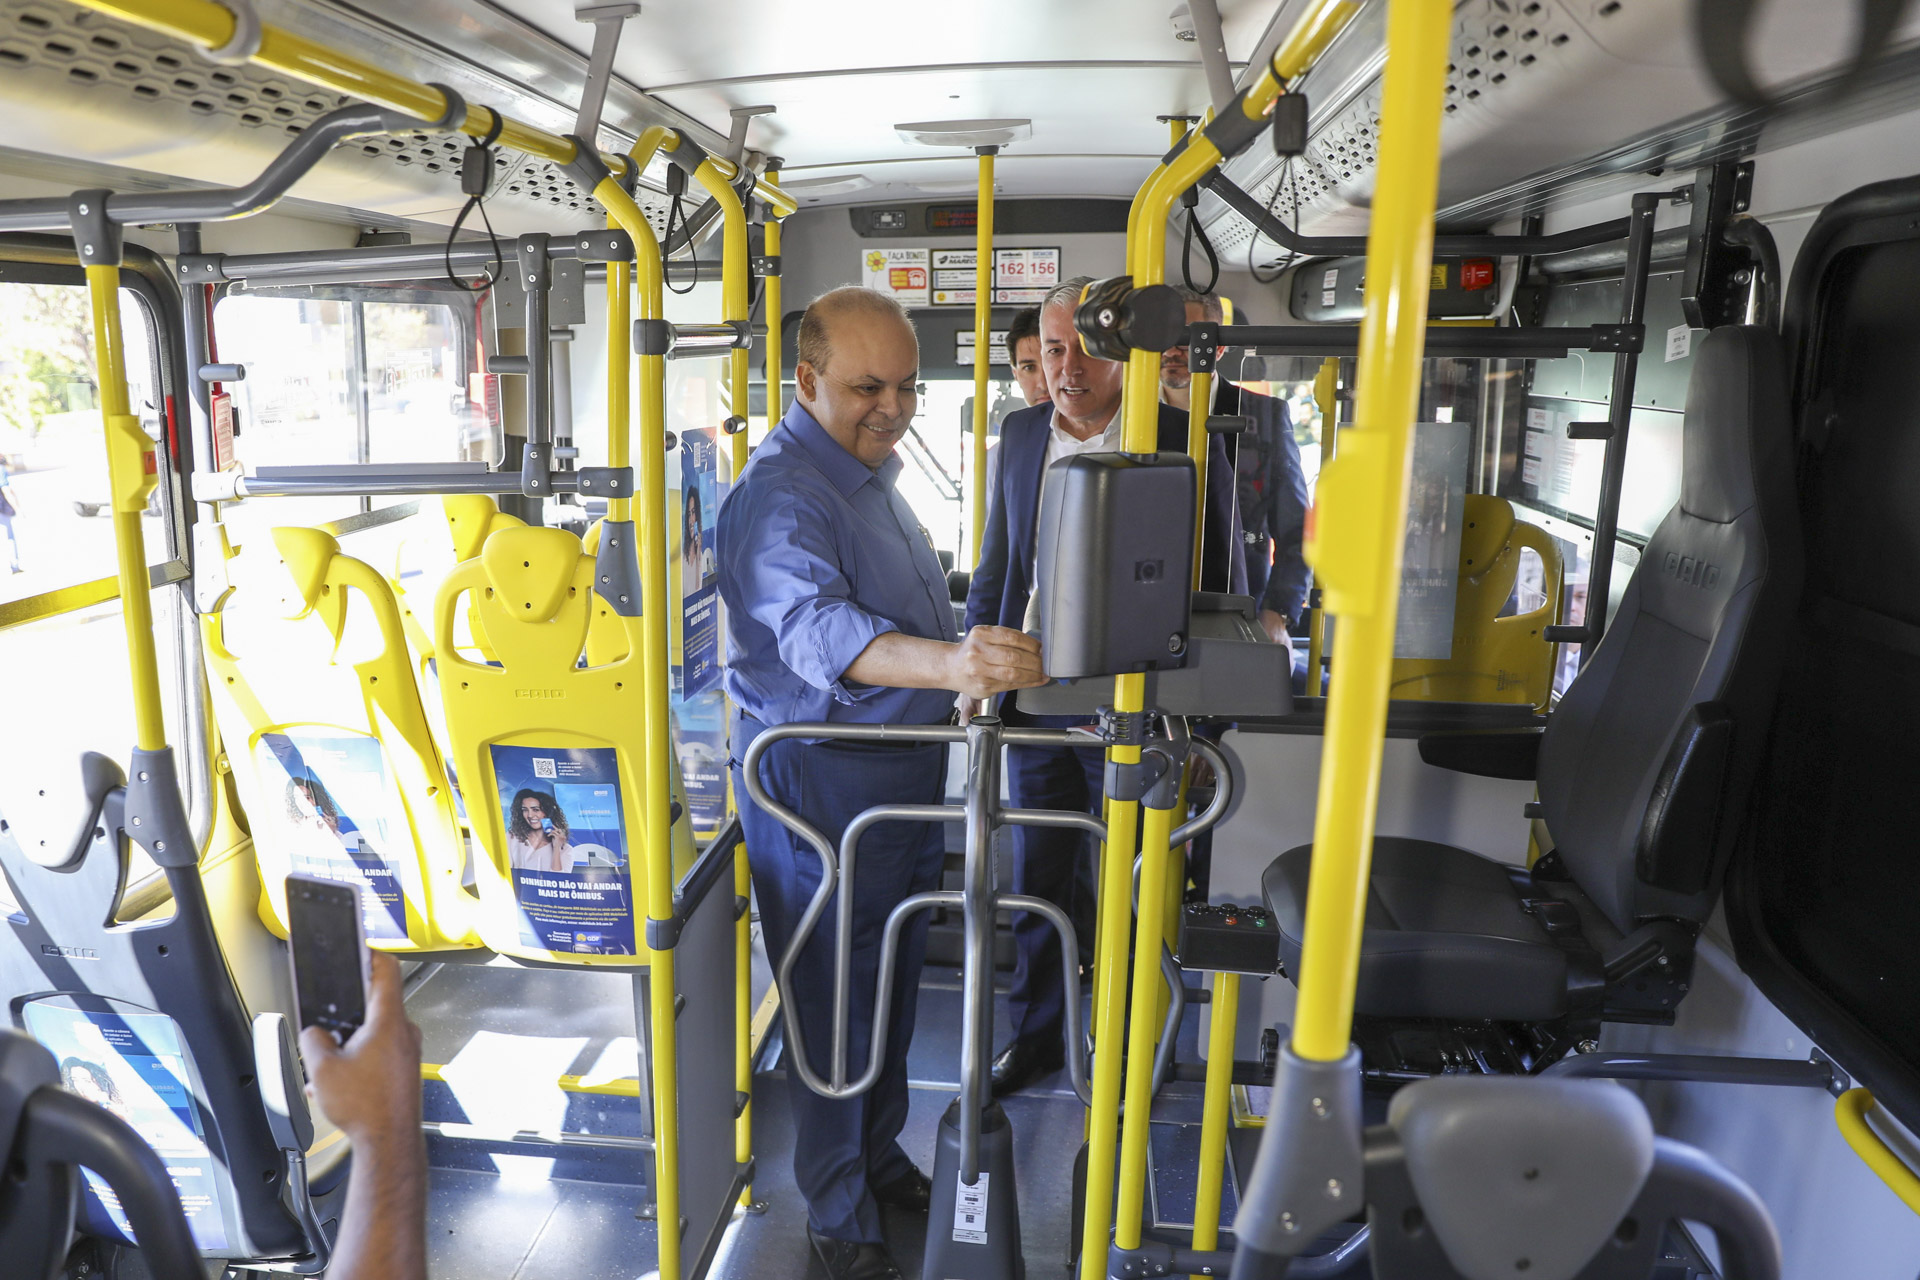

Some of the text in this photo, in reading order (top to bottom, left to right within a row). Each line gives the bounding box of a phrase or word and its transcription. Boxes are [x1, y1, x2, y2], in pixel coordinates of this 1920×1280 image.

[1000, 262, 1024, 275] 162
[1030, 262, 1055, 275] 156
[696, 774, 720, 782] ANDAR
[683, 781, 705, 789] NIBUS.
[364, 868, 393, 877] ANDAR
[520, 876, 623, 891] DINHEIRO NÃO VAI ANDAR
[538, 888, 605, 900] MAIS DE ÔNIBUS.
